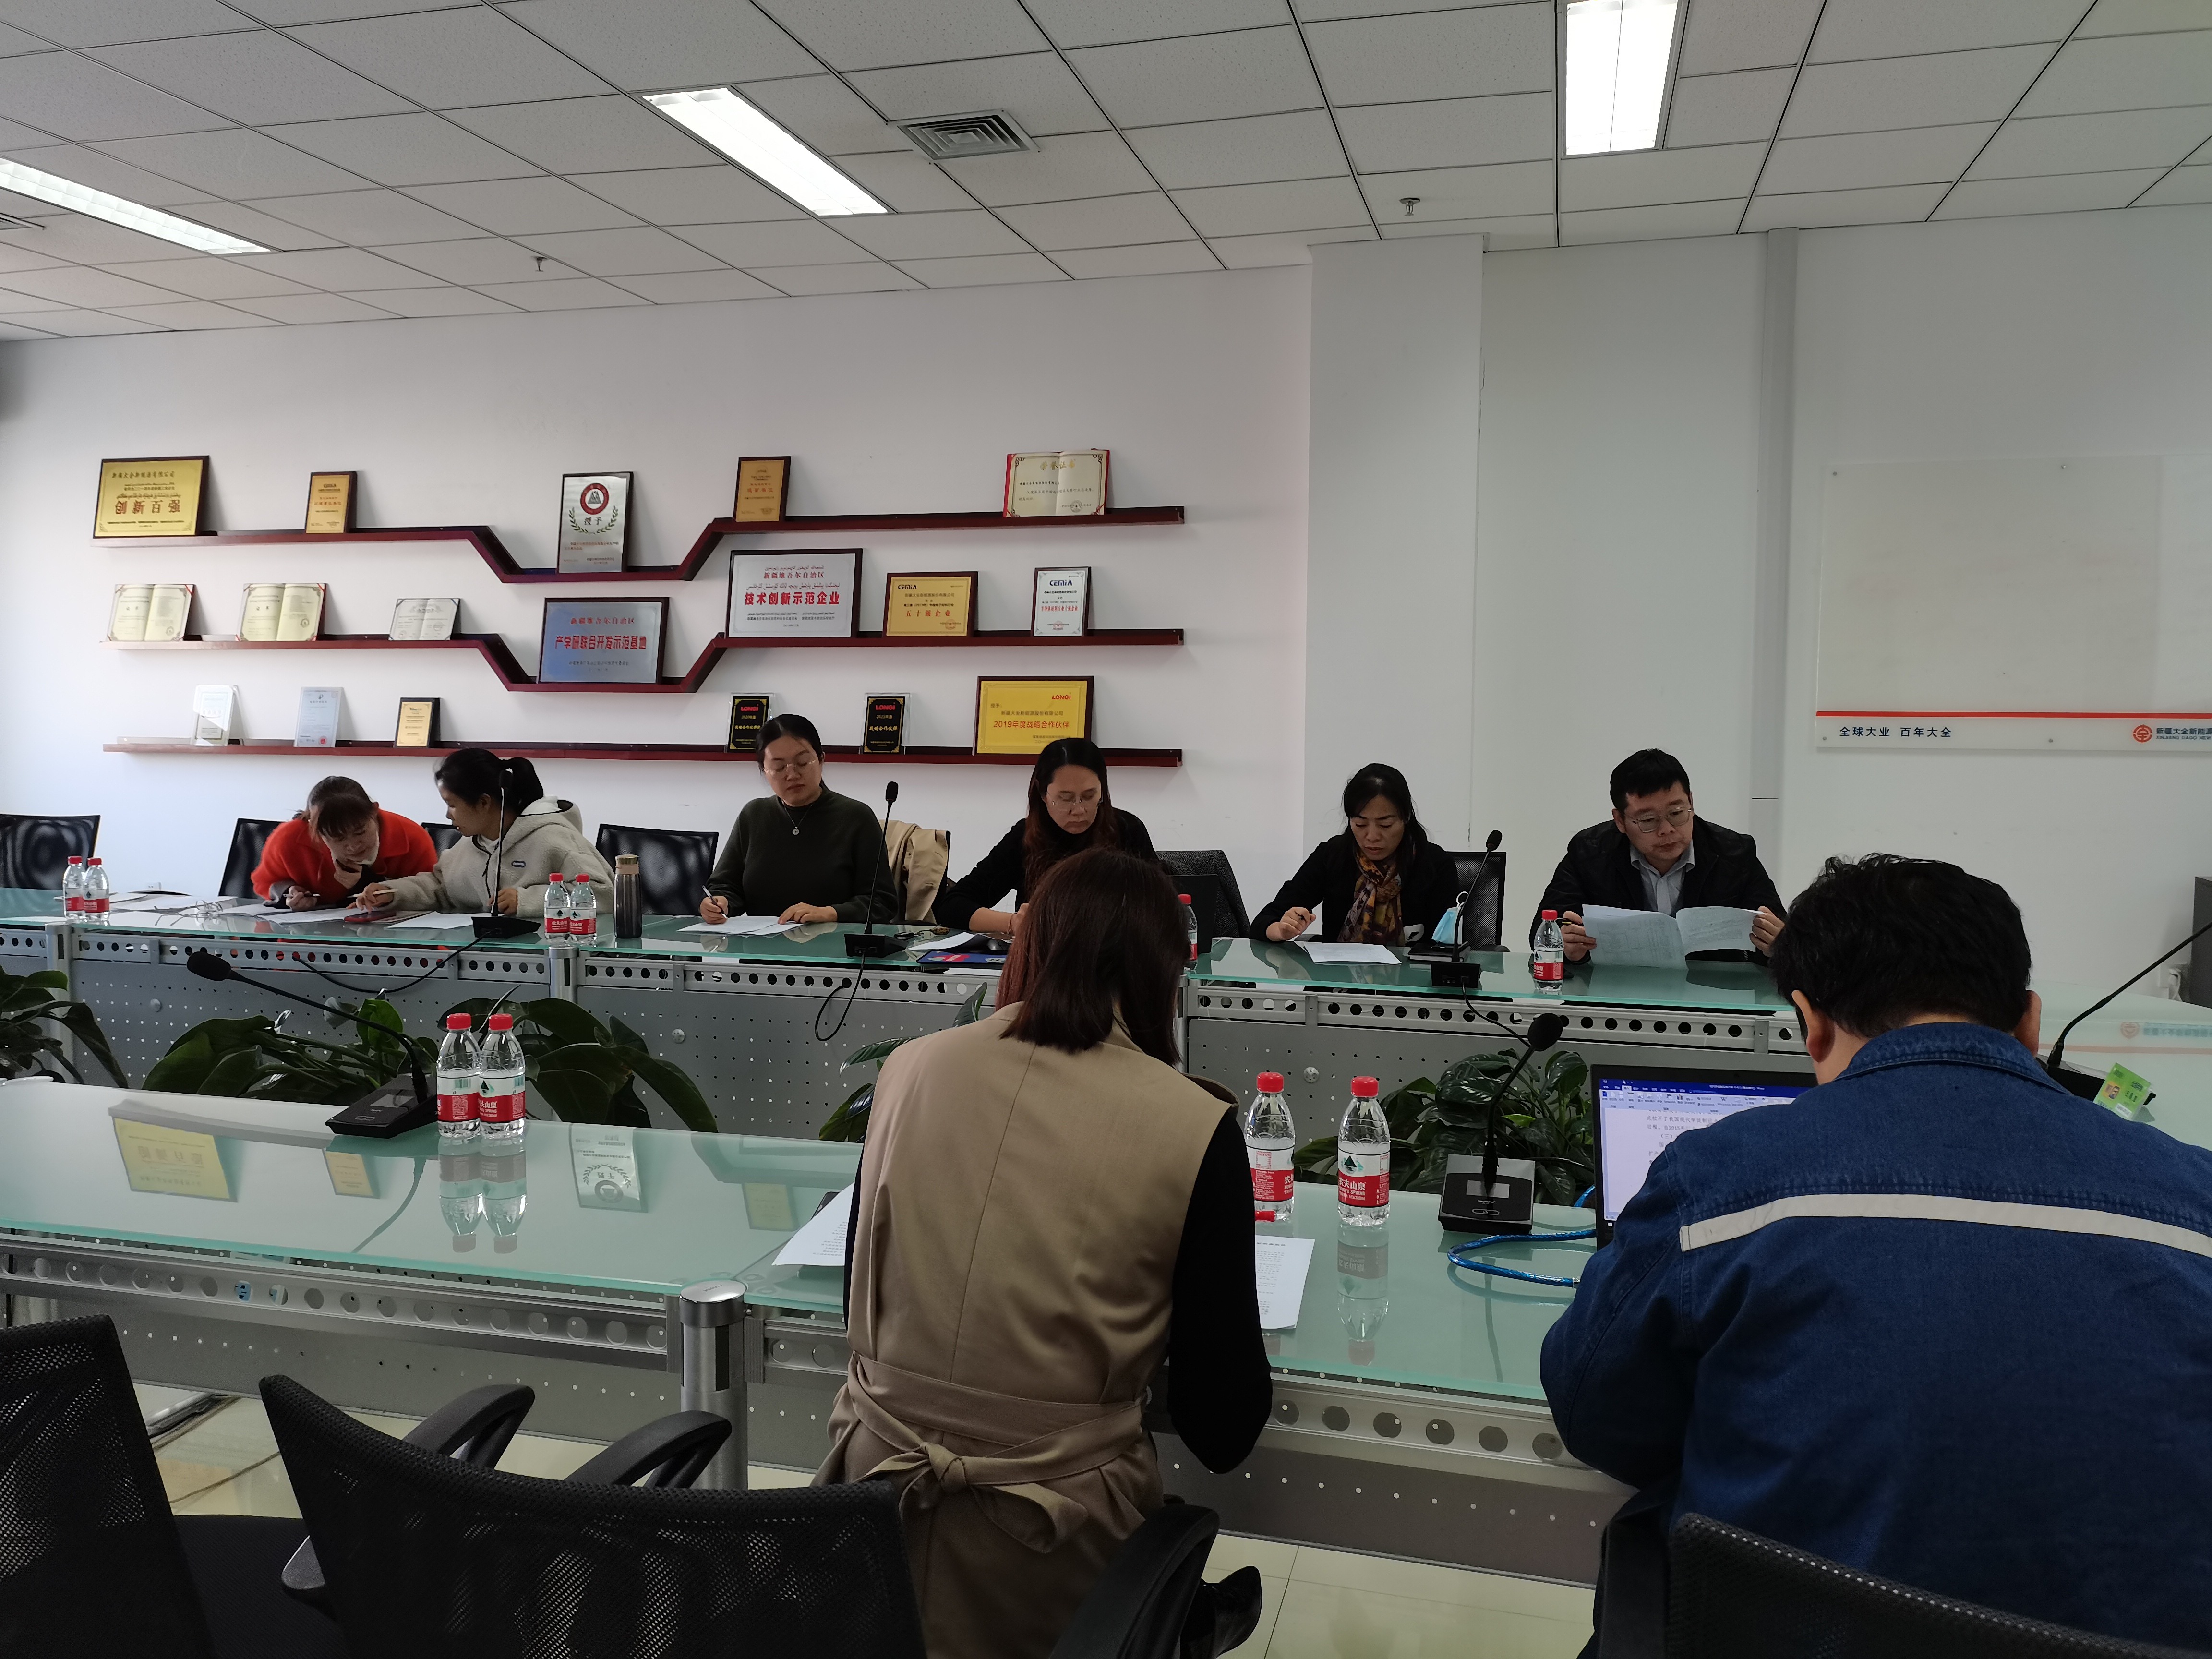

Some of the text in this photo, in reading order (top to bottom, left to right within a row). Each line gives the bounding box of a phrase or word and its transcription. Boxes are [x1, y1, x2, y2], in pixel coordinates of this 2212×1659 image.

[115, 500, 180, 514] 创新百强
[745, 591, 840, 605] 技术创新示范企业
[555, 635, 647, 649] 产学研联合开发示范基地
[1839, 726, 1951, 737] 全球大业 百年大全
[1339, 1177, 1365, 1190] 农夫山泉
